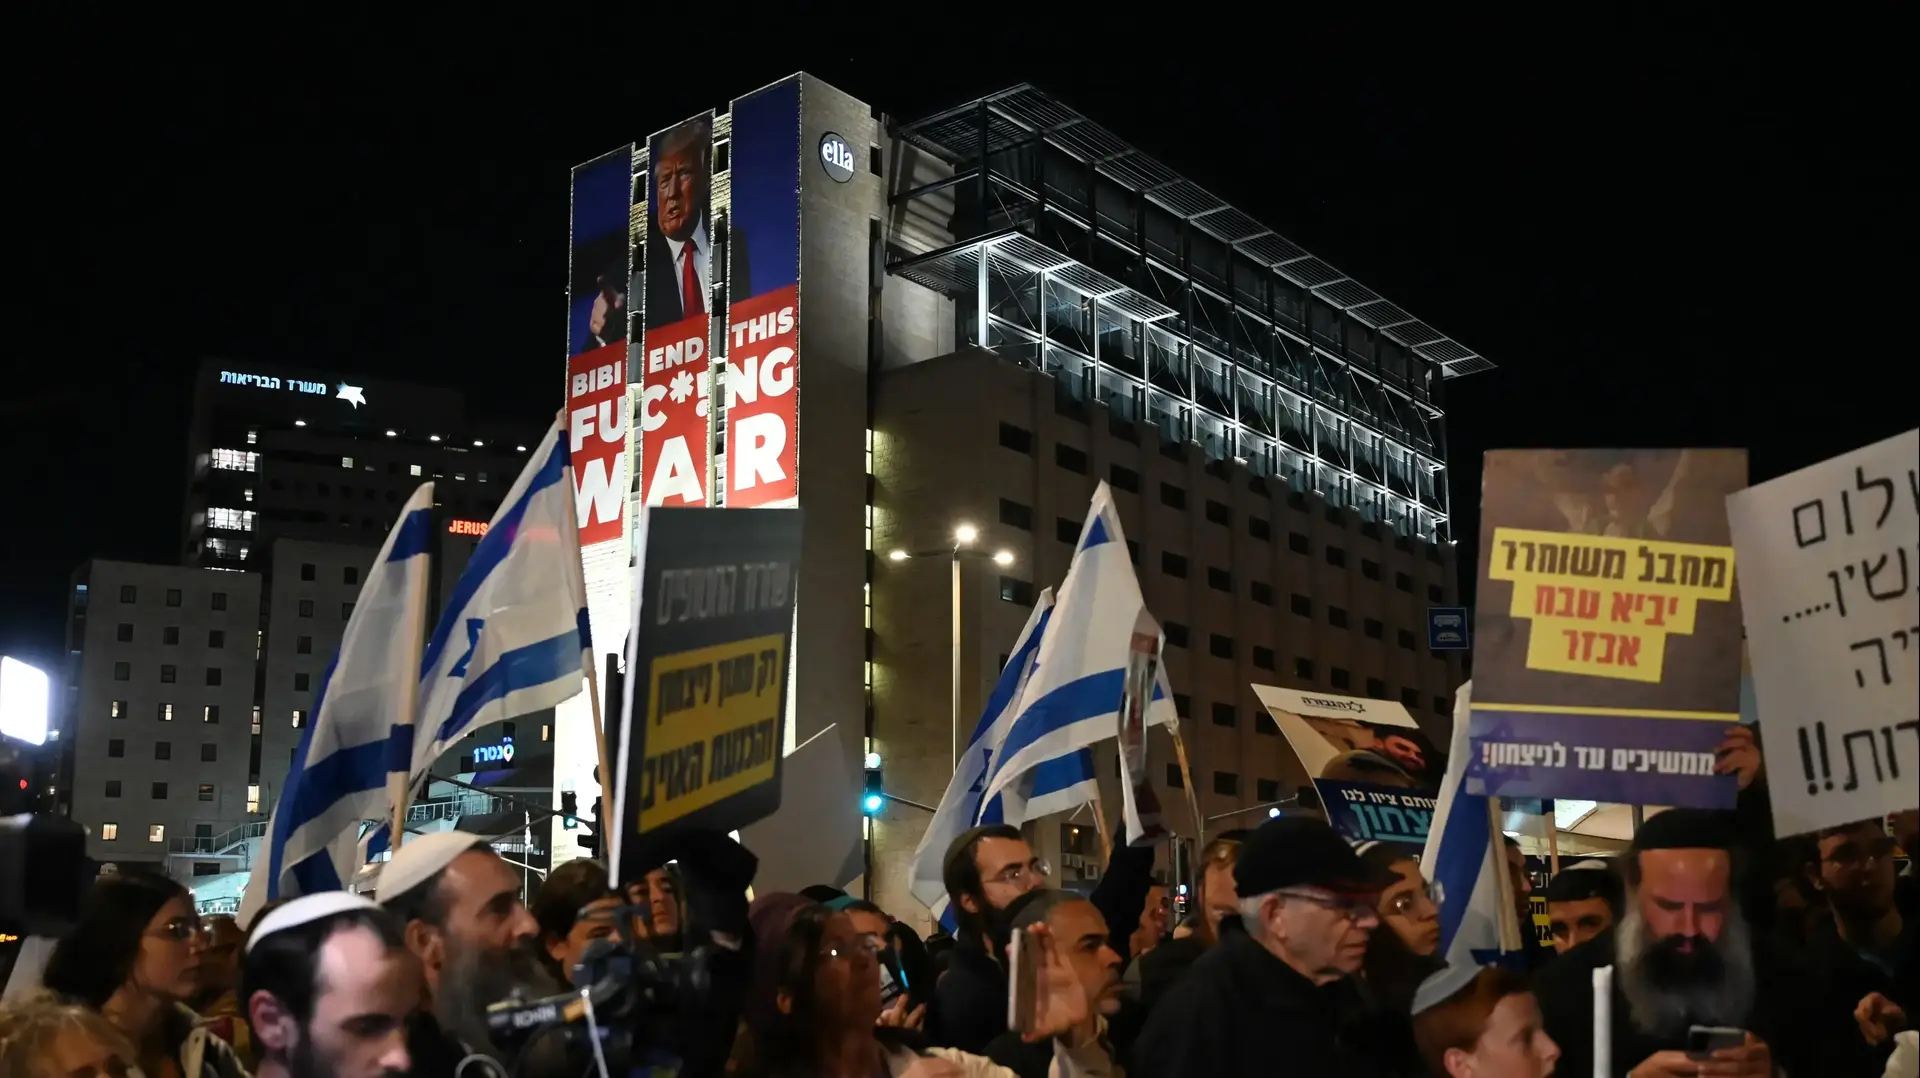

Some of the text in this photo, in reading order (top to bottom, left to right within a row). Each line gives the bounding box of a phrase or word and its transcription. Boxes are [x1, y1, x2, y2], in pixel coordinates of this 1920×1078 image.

[822, 140, 855, 173] ella
[572, 306, 794, 398] BIBI END THIS
[220, 370, 327, 395] משרד הבריאות
[571, 412, 787, 529] WAR
[1792, 465, 1919, 549] לום
[448, 519, 489, 537] JERUS
[1501, 540, 1727, 589] מחבל משוחרר
[1535, 584, 1679, 626] יביא טבח
[1782, 546, 1919, 624] שין.....
[1562, 629, 1642, 668] אכזר
[1849, 626, 1919, 689] יה
[1482, 741, 1717, 776] ממשיכים עד לניצחון!
[1341, 788, 1437, 809] מותם ציוו לנו
[1349, 804, 1432, 838] צחון
